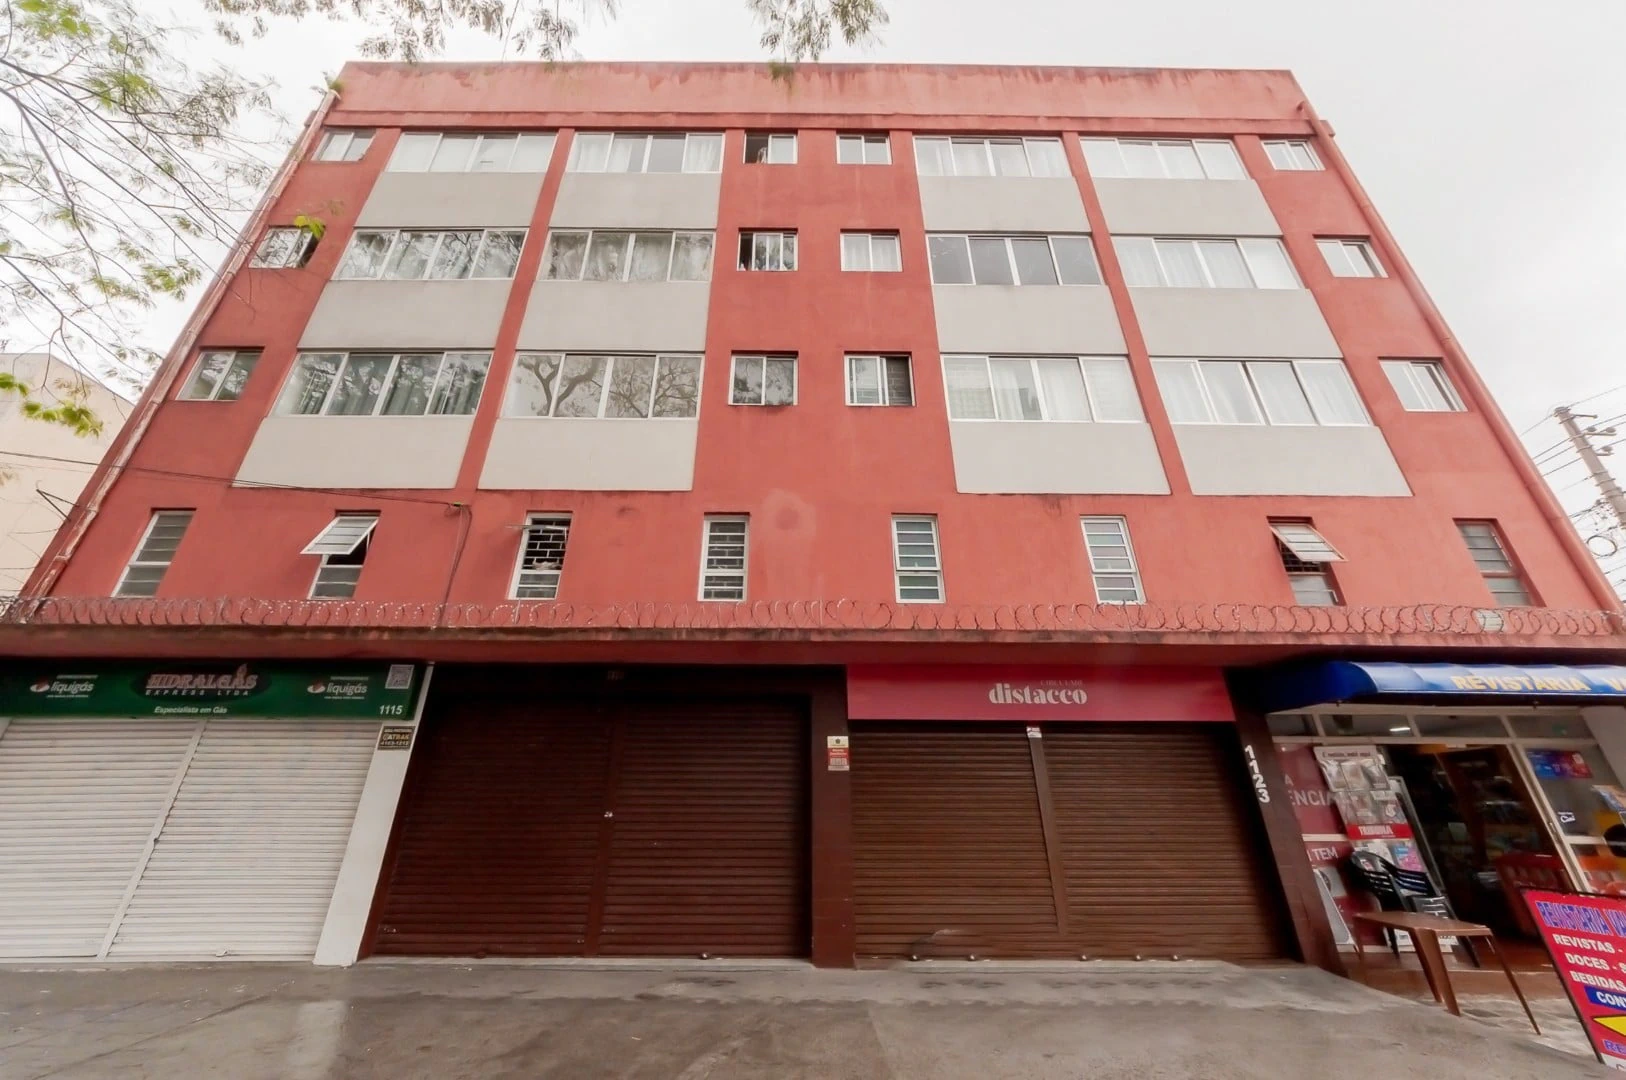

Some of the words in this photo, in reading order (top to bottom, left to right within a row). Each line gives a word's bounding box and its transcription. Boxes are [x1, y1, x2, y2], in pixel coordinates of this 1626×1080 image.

[50, 681, 95, 694] liquigás
[326, 683, 368, 695] liquigás
[1451, 675, 1593, 691] REVISTARIA
[988, 683, 1088, 705] distacco
[154, 706, 199, 714] Especialista
[212, 706, 228, 714] Gás
[380, 704, 404, 715] 1115
[1244, 744, 1271, 804] 1123
[1311, 846, 1339, 862] TEM
[1552, 933, 1616, 954] REVISTAS
[1564, 952, 1610, 971] DOCES
[1570, 970, 1626, 992] BEBIDAS
